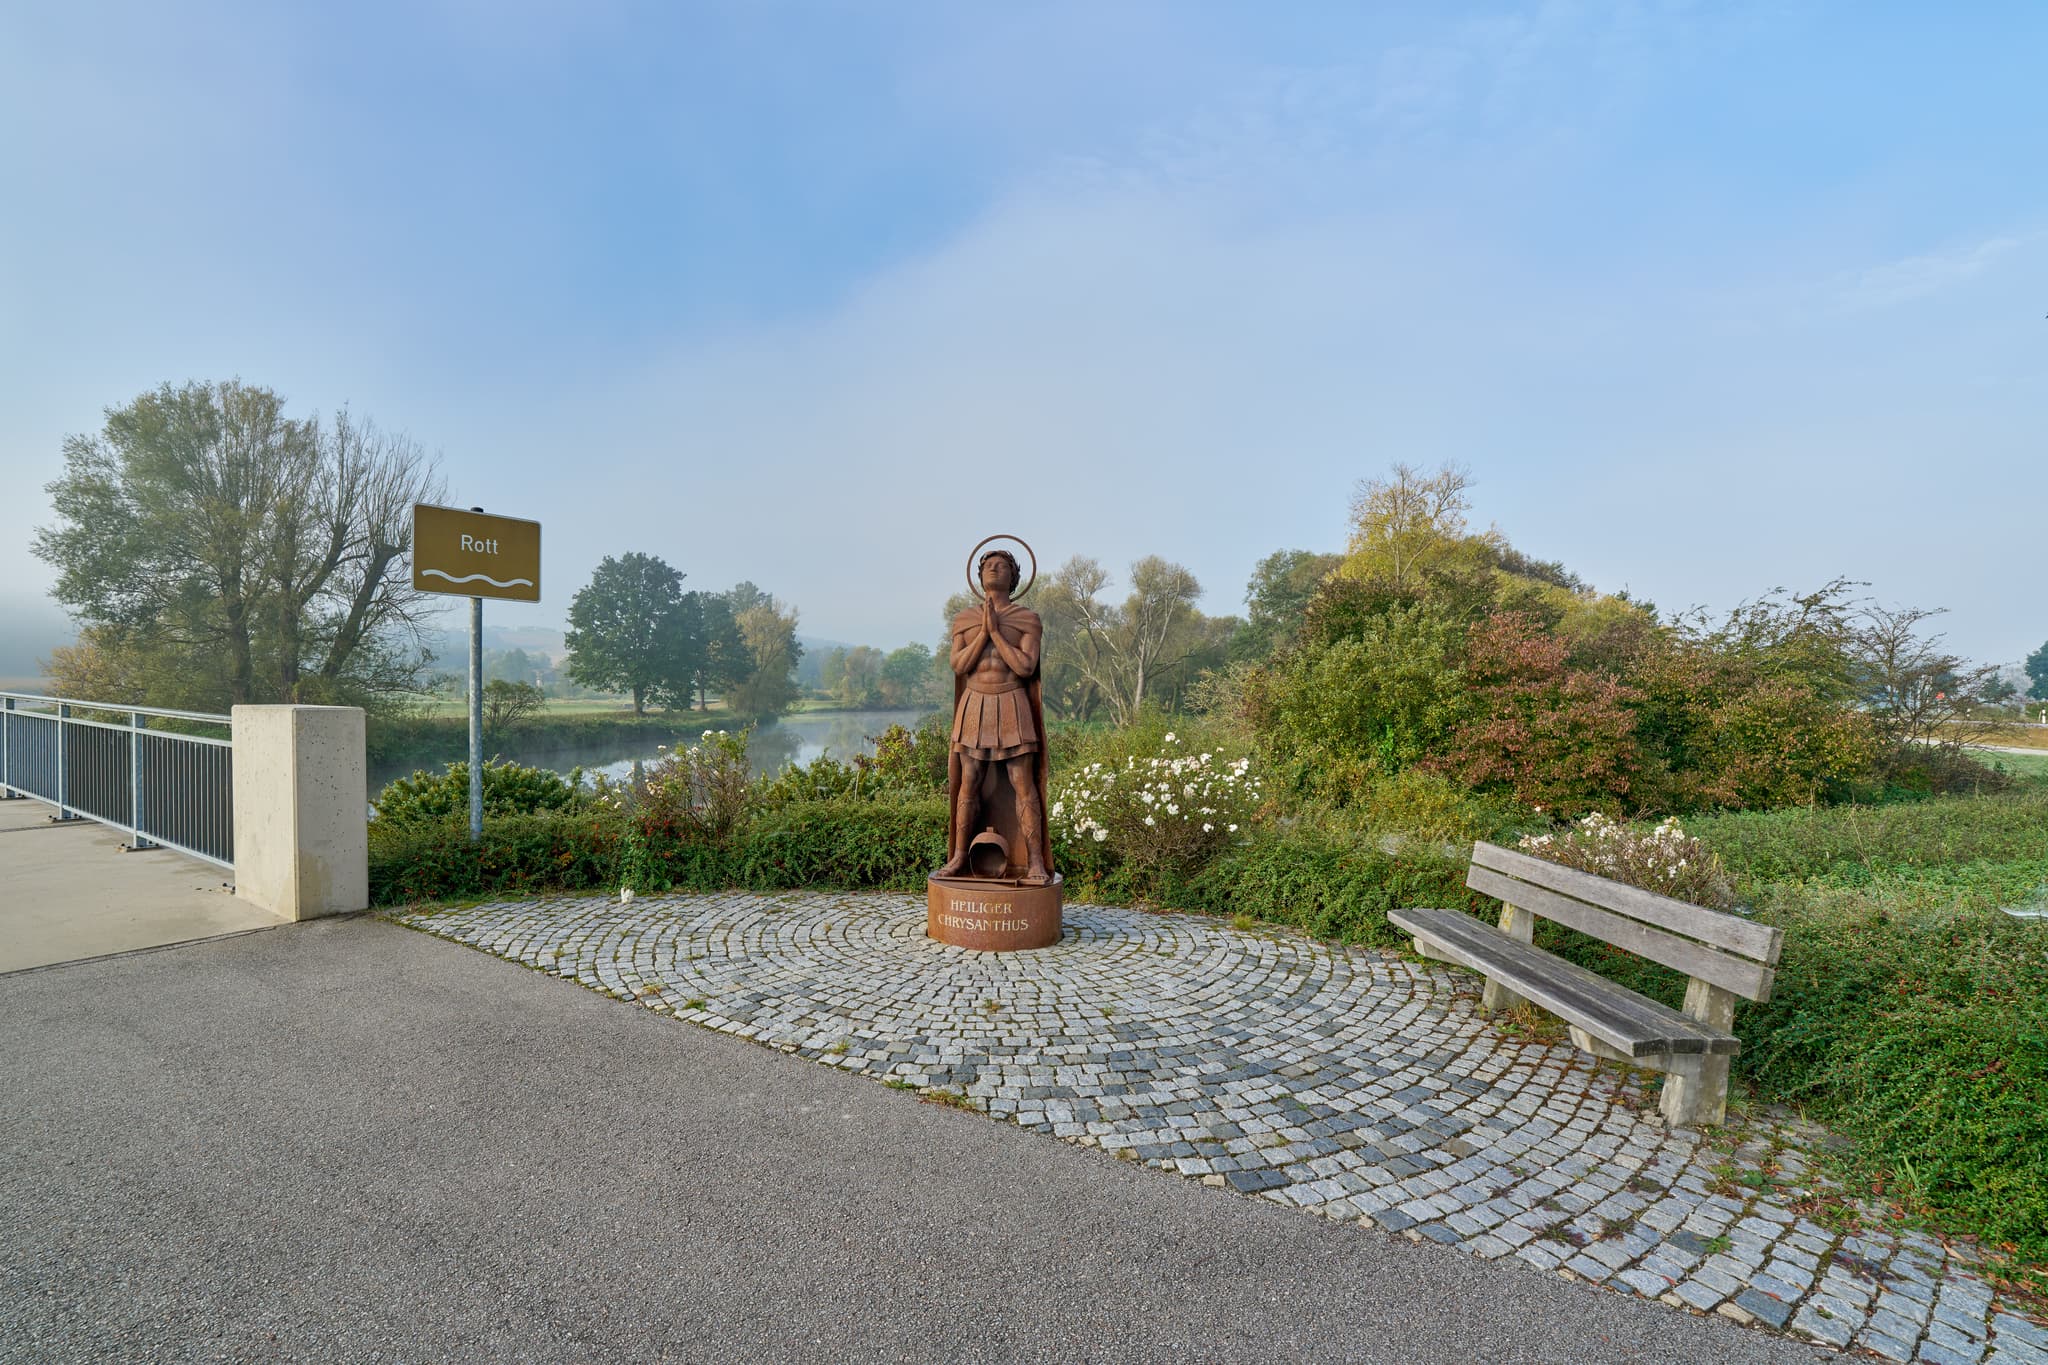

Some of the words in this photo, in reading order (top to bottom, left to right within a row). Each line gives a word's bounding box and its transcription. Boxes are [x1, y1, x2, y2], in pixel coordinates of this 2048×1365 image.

[461, 534, 498, 555] Rott
[951, 899, 1012, 914] HEILIGER
[938, 914, 1029, 931] CHRYSANTHUS
